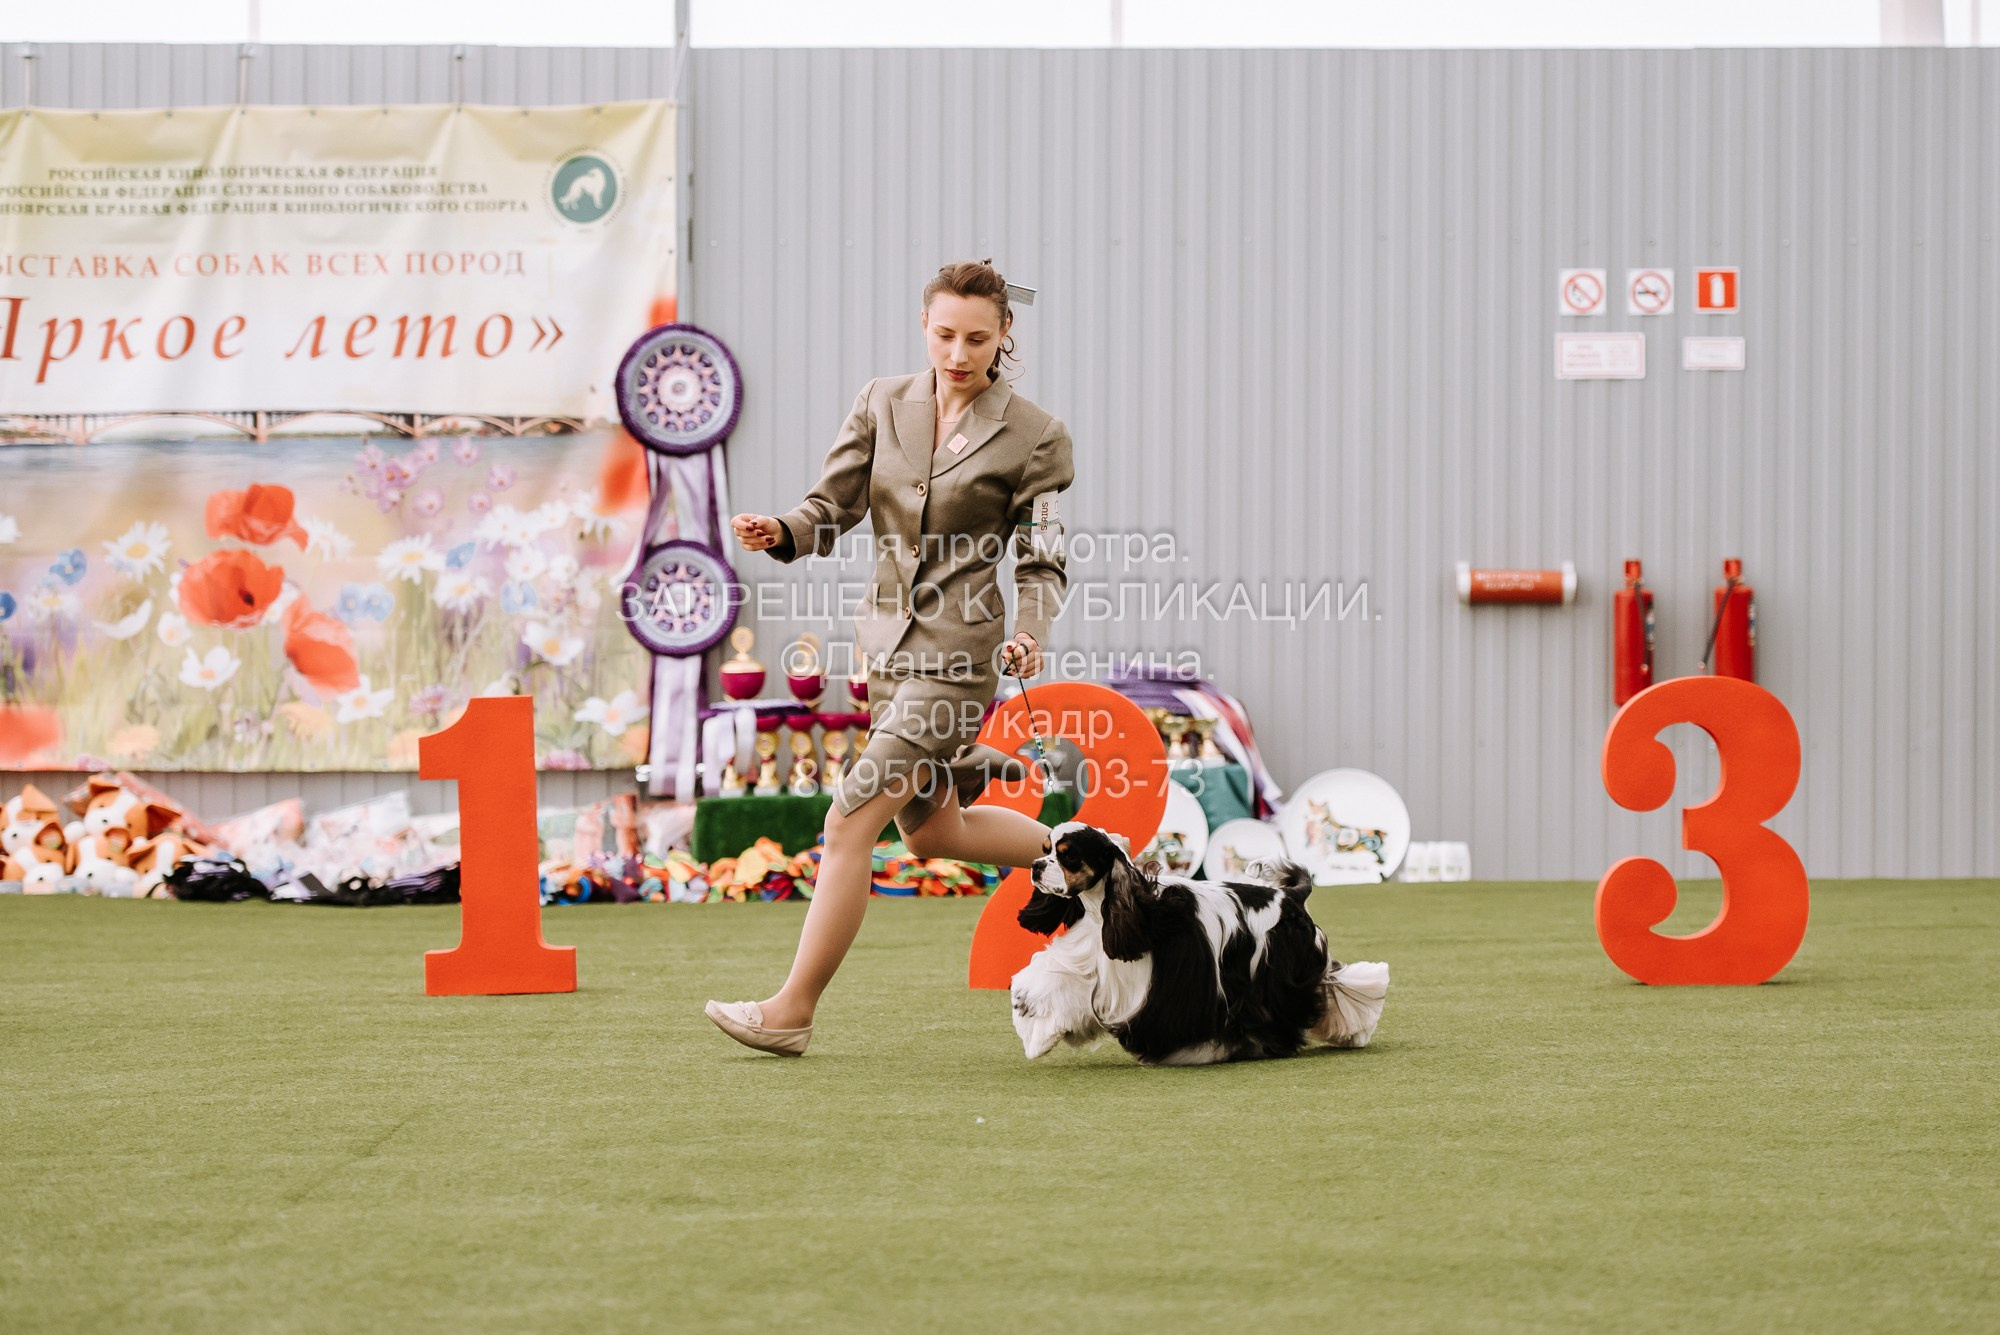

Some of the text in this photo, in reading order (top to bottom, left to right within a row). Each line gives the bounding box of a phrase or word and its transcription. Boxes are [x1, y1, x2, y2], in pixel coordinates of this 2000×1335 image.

[48, 167, 161, 182] РОССИЙСКАЯ
[333, 165, 437, 179] ФЕДЕРАЦИЯ
[115, 185, 217, 199] ФЕДЕРАЦИЯ
[222, 183, 339, 197] СЛУЖЕБНОГО
[344, 182, 489, 197] СОБАКОВОДСТВА
[95, 203, 171, 216] КРАЕВАЯ
[176, 202, 279, 216] ФЕДЕРАЦИЯ
[284, 201, 460, 215] КИНОЛОГИЧЕСКОГО
[463, 200, 530, 213] СПОРТА
[174, 252, 291, 278] СОБАК
[306, 252, 391, 277] ВСЕХ
[405, 251, 526, 278] ПОРОД
[1040, 501, 1049, 531] SRIUS
[968, 681, 1169, 990] 2
[1594, 675, 1810, 986] 3
[418, 694, 577, 996] 1
